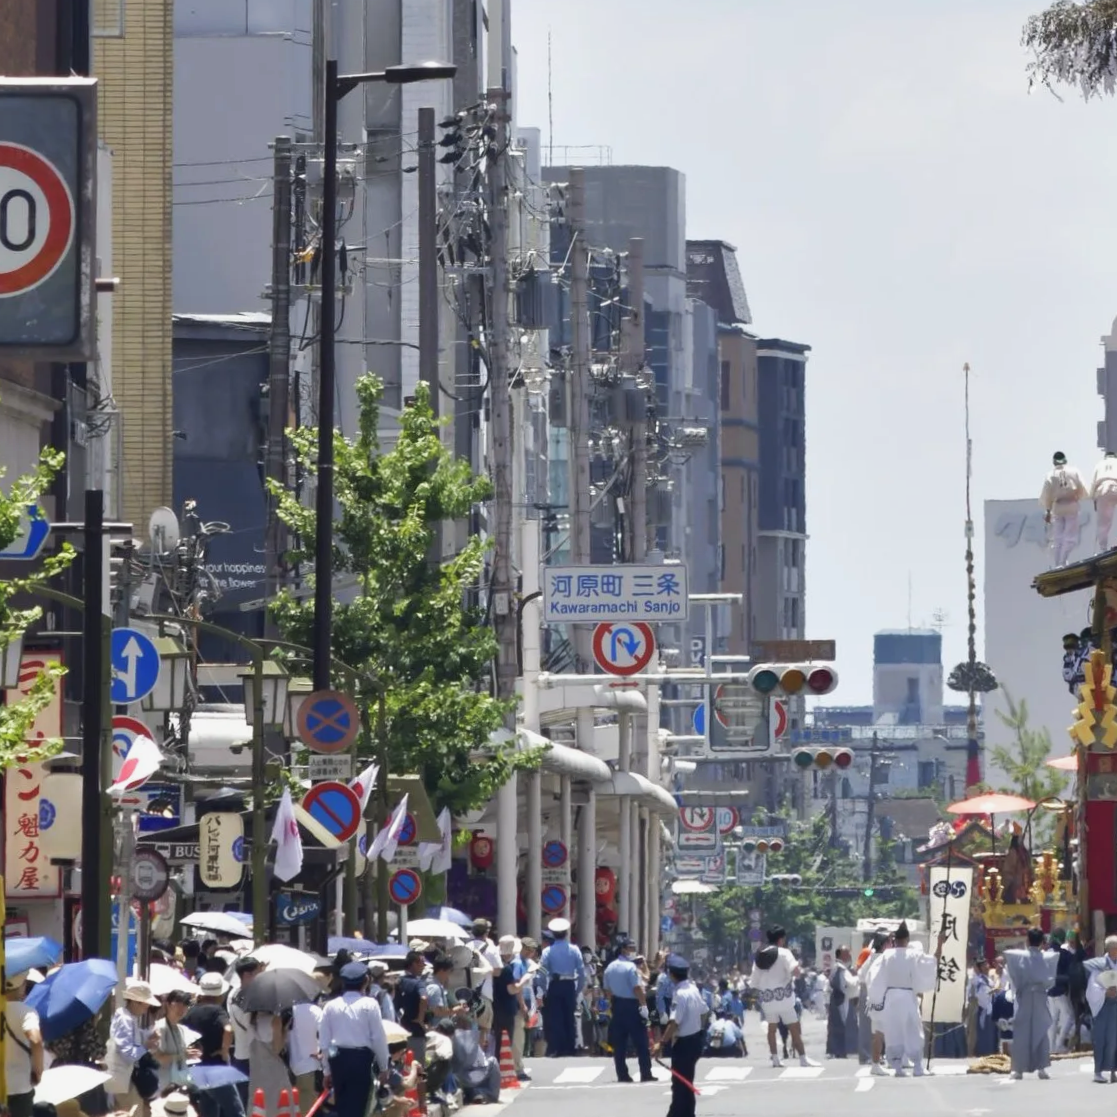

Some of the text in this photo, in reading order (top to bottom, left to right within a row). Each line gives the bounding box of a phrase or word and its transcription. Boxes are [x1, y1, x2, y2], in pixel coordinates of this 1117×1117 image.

[0, 188, 36, 252] 0
[223, 562, 267, 575] happines
[551, 573, 680, 598] 河原町 三条
[551, 600, 680, 615] Kawaramachi Sanjo
[175, 845, 200, 858] BUS
